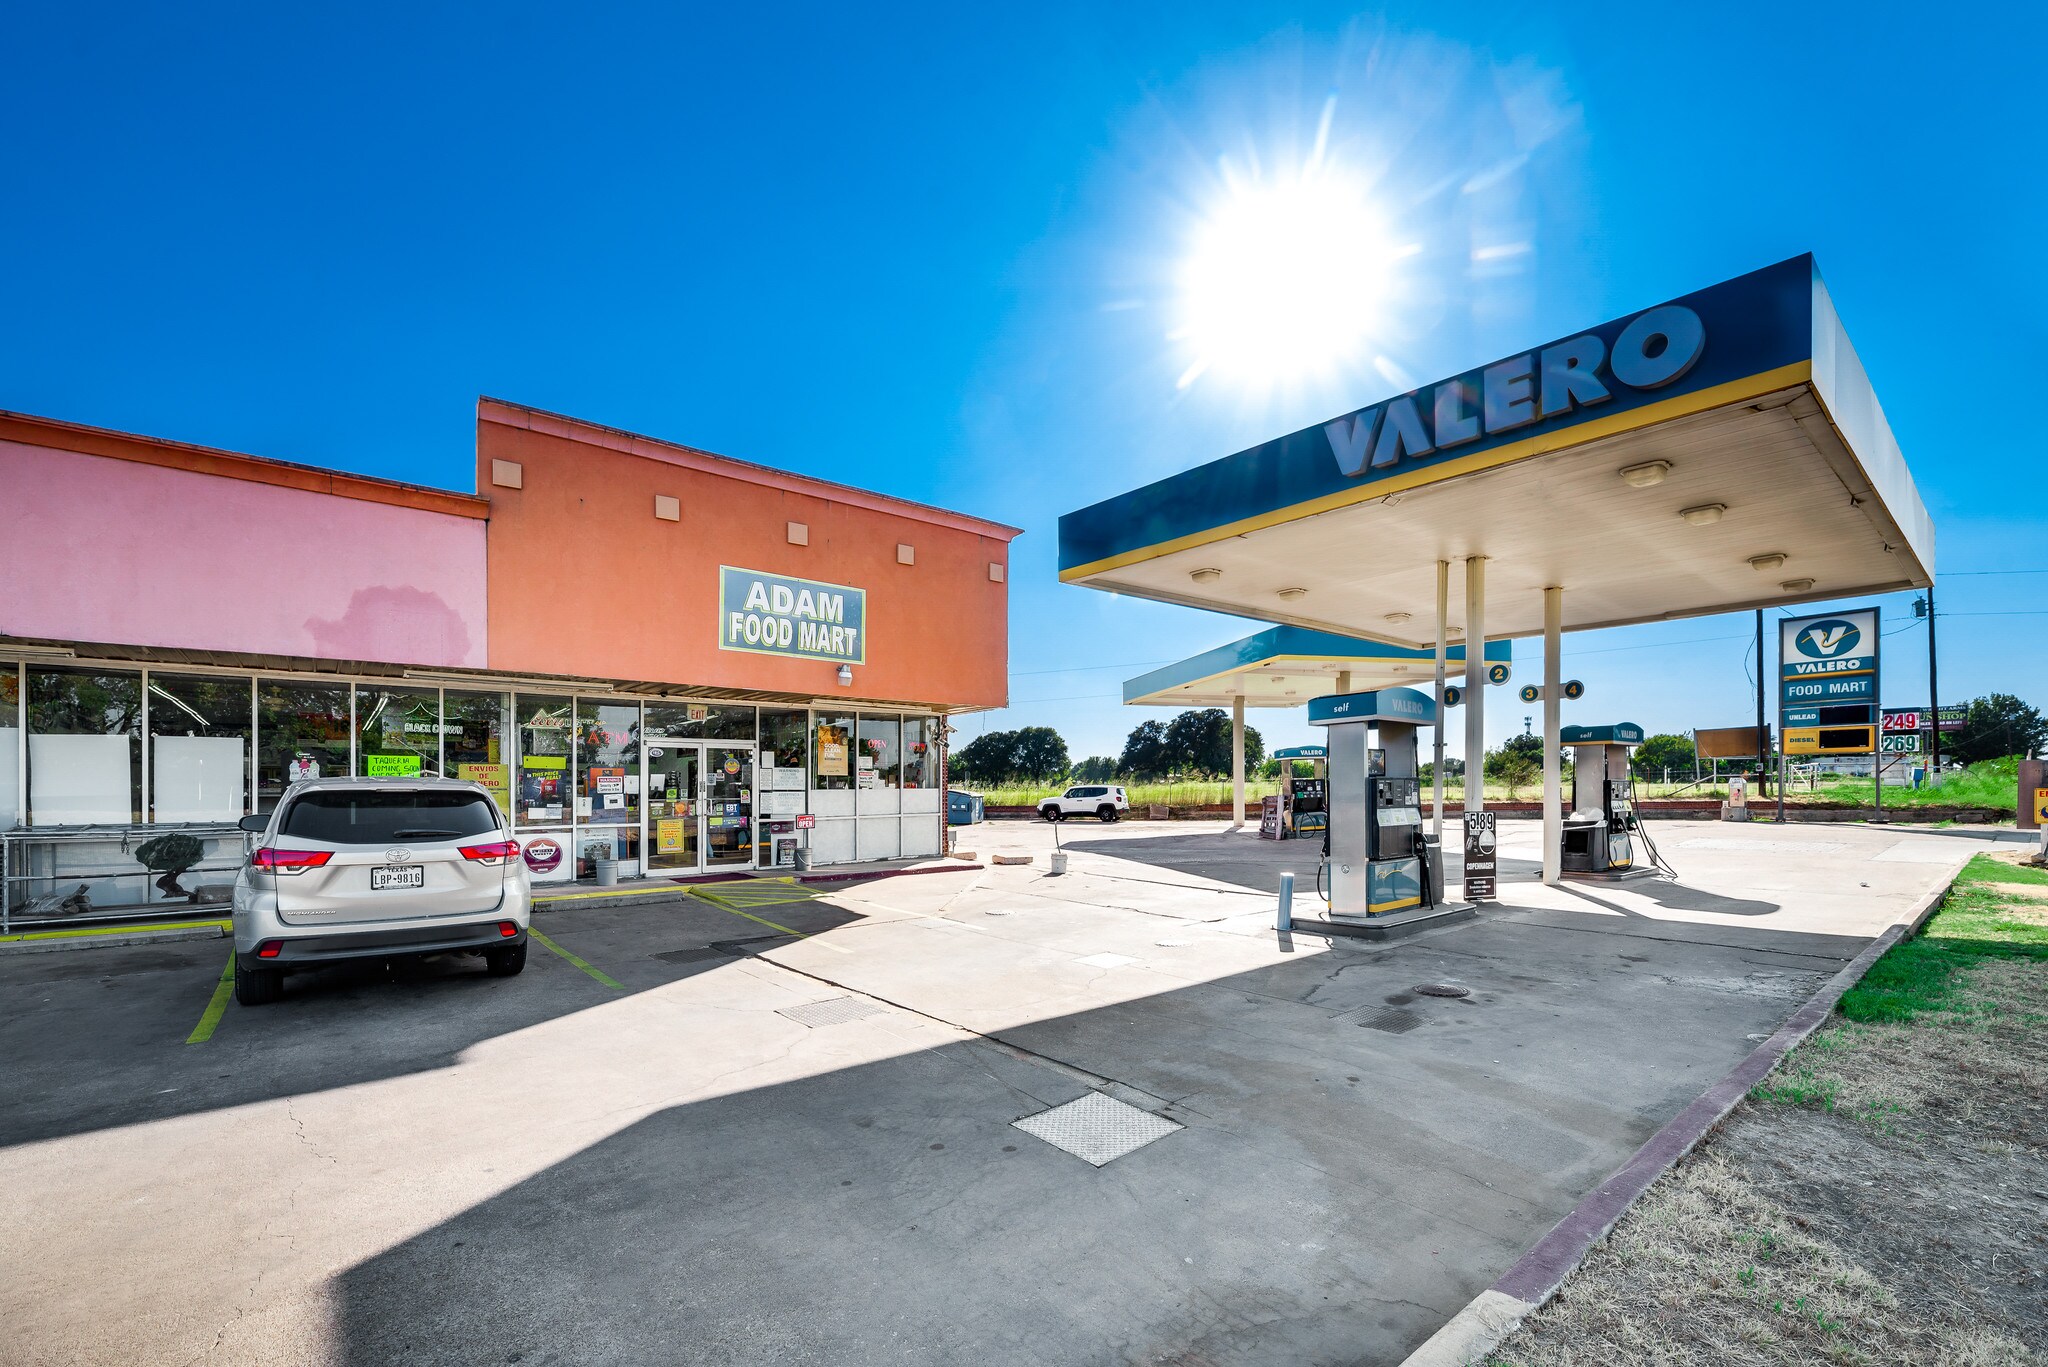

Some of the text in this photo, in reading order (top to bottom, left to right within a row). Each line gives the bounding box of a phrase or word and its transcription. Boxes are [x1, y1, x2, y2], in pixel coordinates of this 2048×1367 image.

[1324, 305, 1706, 479] VALERO
[743, 581, 844, 624] ADAM
[729, 611, 857, 656] FOOD MART
[1795, 659, 1861, 673] VALERO
[1494, 668, 1504, 680] 2
[1525, 689, 1534, 699] 3
[1568, 685, 1577, 695] 4
[1788, 681, 1868, 697] FOOD MART
[1447, 691, 1454, 702] 1
[1333, 702, 1350, 713] self
[1392, 699, 1424, 715] VALERO
[1883, 713, 1916, 730] 249
[404, 722, 431, 733] BLACK
[587, 731, 628, 745] ATM
[1621, 729, 1638, 740] VALERO
[867, 739, 888, 749] OPEN
[1883, 736, 1916, 752] 269
[725, 803, 738, 811] EBT
[798, 820, 812, 828] OPEN
[1466, 862, 1495, 871] COPENHAGEN
